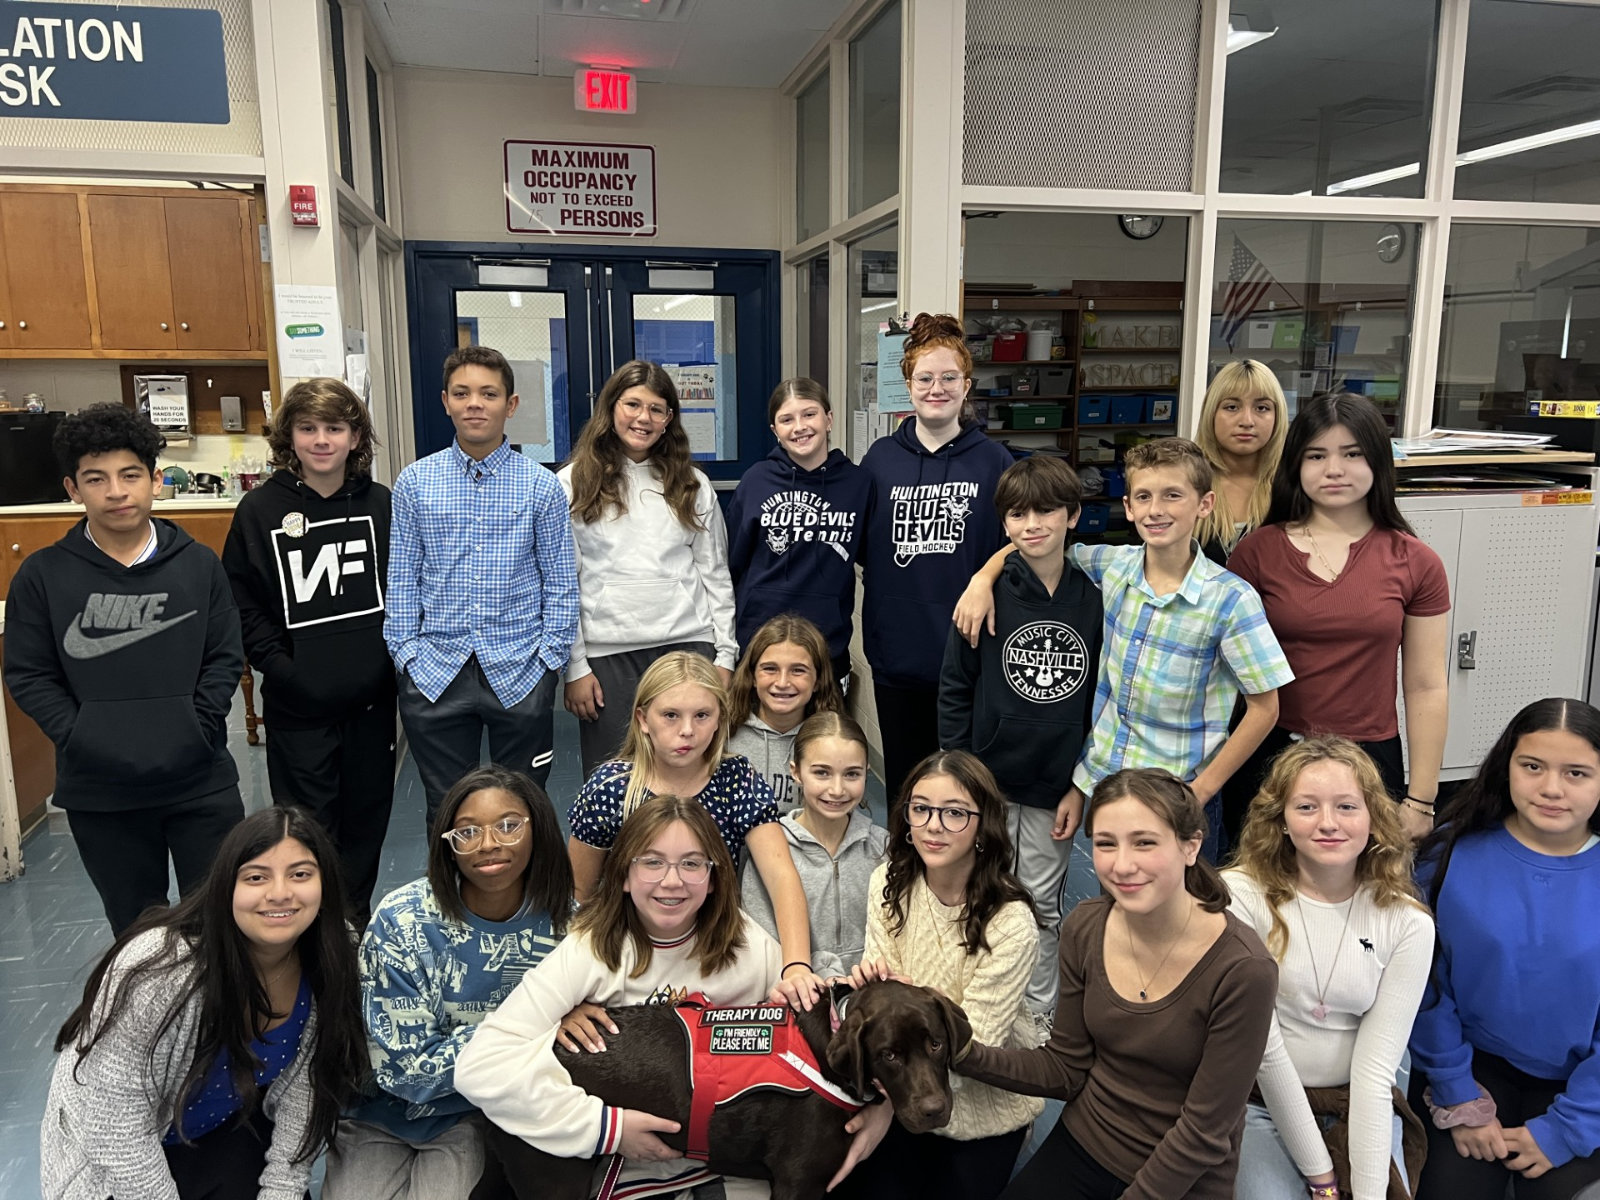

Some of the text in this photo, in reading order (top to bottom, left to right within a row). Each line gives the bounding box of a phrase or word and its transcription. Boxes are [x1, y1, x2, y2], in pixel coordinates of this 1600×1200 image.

[586, 71, 630, 111] EXIT
[532, 149, 629, 169] MAXIMUM
[523, 170, 637, 191] OCCUPANCY
[530, 192, 633, 207] NOT TO EXCEED
[560, 209, 644, 228] PERSONS
[761, 490, 831, 512] HUNTINGTON
[890, 482, 979, 500] HUNTINGTON
[760, 511, 856, 527] BLUE DEVILS
[893, 499, 950, 521] BLUE
[792, 527, 852, 543] Tennis
[893, 519, 966, 543] DEVILS
[899, 543, 954, 553] FIELD HOCKEY
[81, 593, 168, 629] NIKE
[1016, 627, 1080, 651] MUSIC CITY
[1008, 649, 1083, 670] NASHVILLE
[1010, 669, 1078, 698] TENNESSEE
[705, 1008, 783, 1022] THERAPY DOG
[723, 1028, 761, 1037] I'M FRIENDLY
[712, 1038, 770, 1050] PLEASE PET ME
